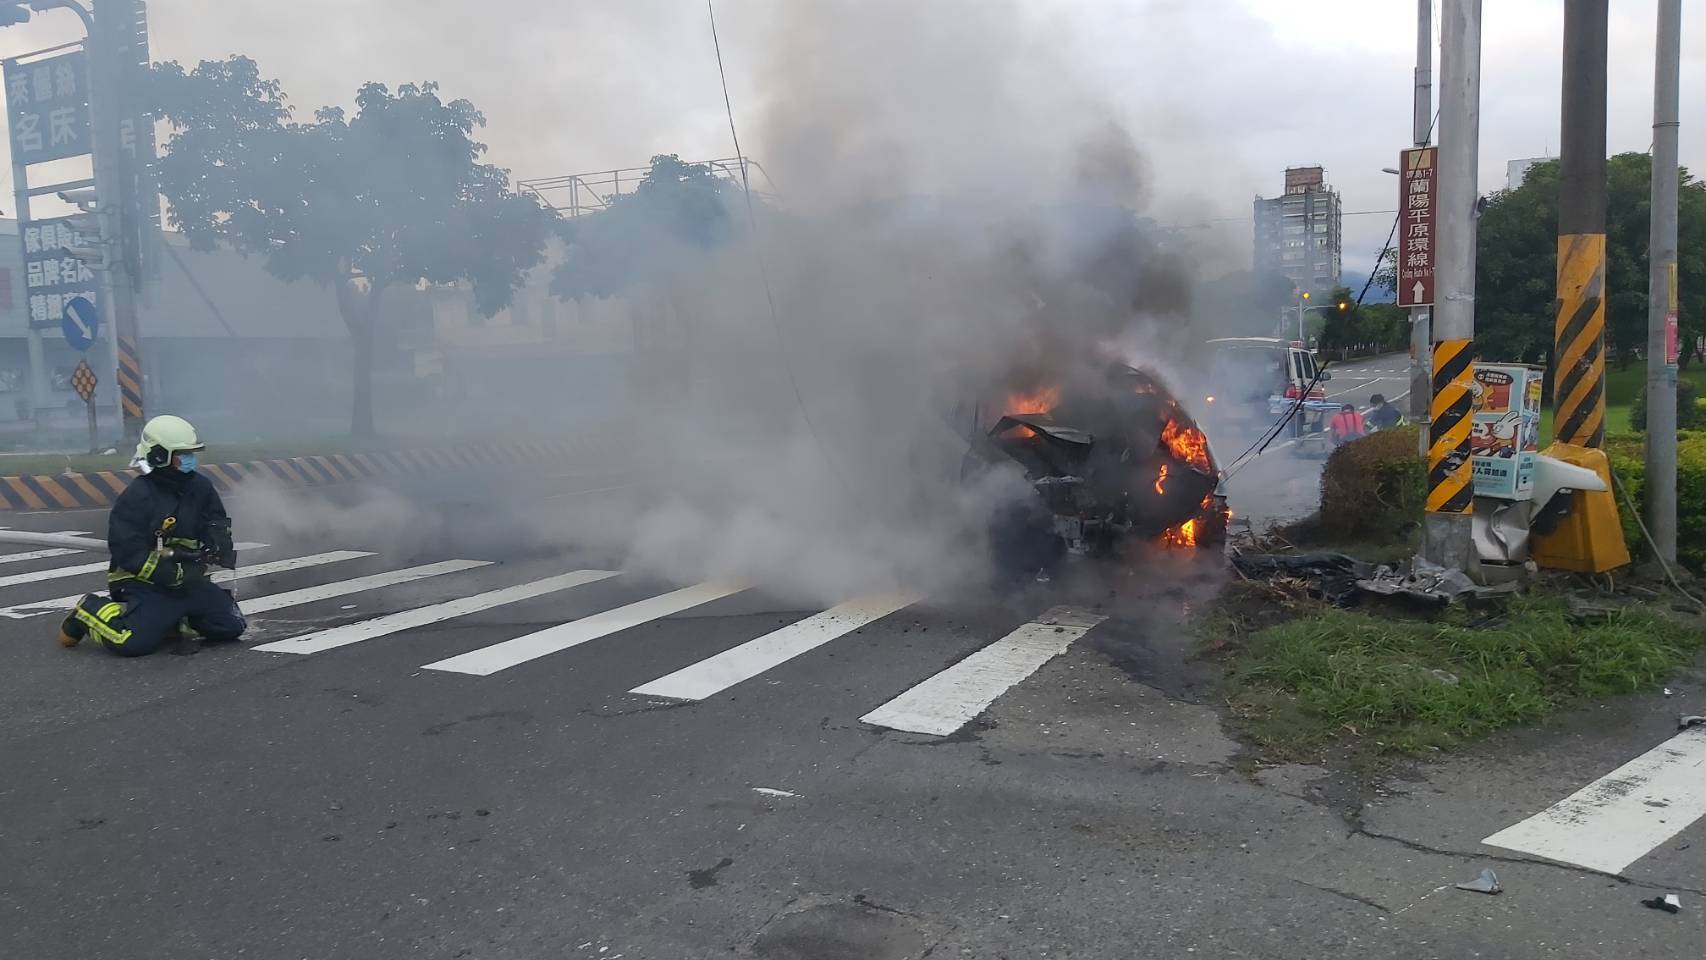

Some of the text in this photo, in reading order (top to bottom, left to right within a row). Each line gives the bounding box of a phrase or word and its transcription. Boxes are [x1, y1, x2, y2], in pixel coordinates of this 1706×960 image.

[16, 107, 78, 152] 名床
[1407, 178, 1430, 268] 蘭陽平原環線
